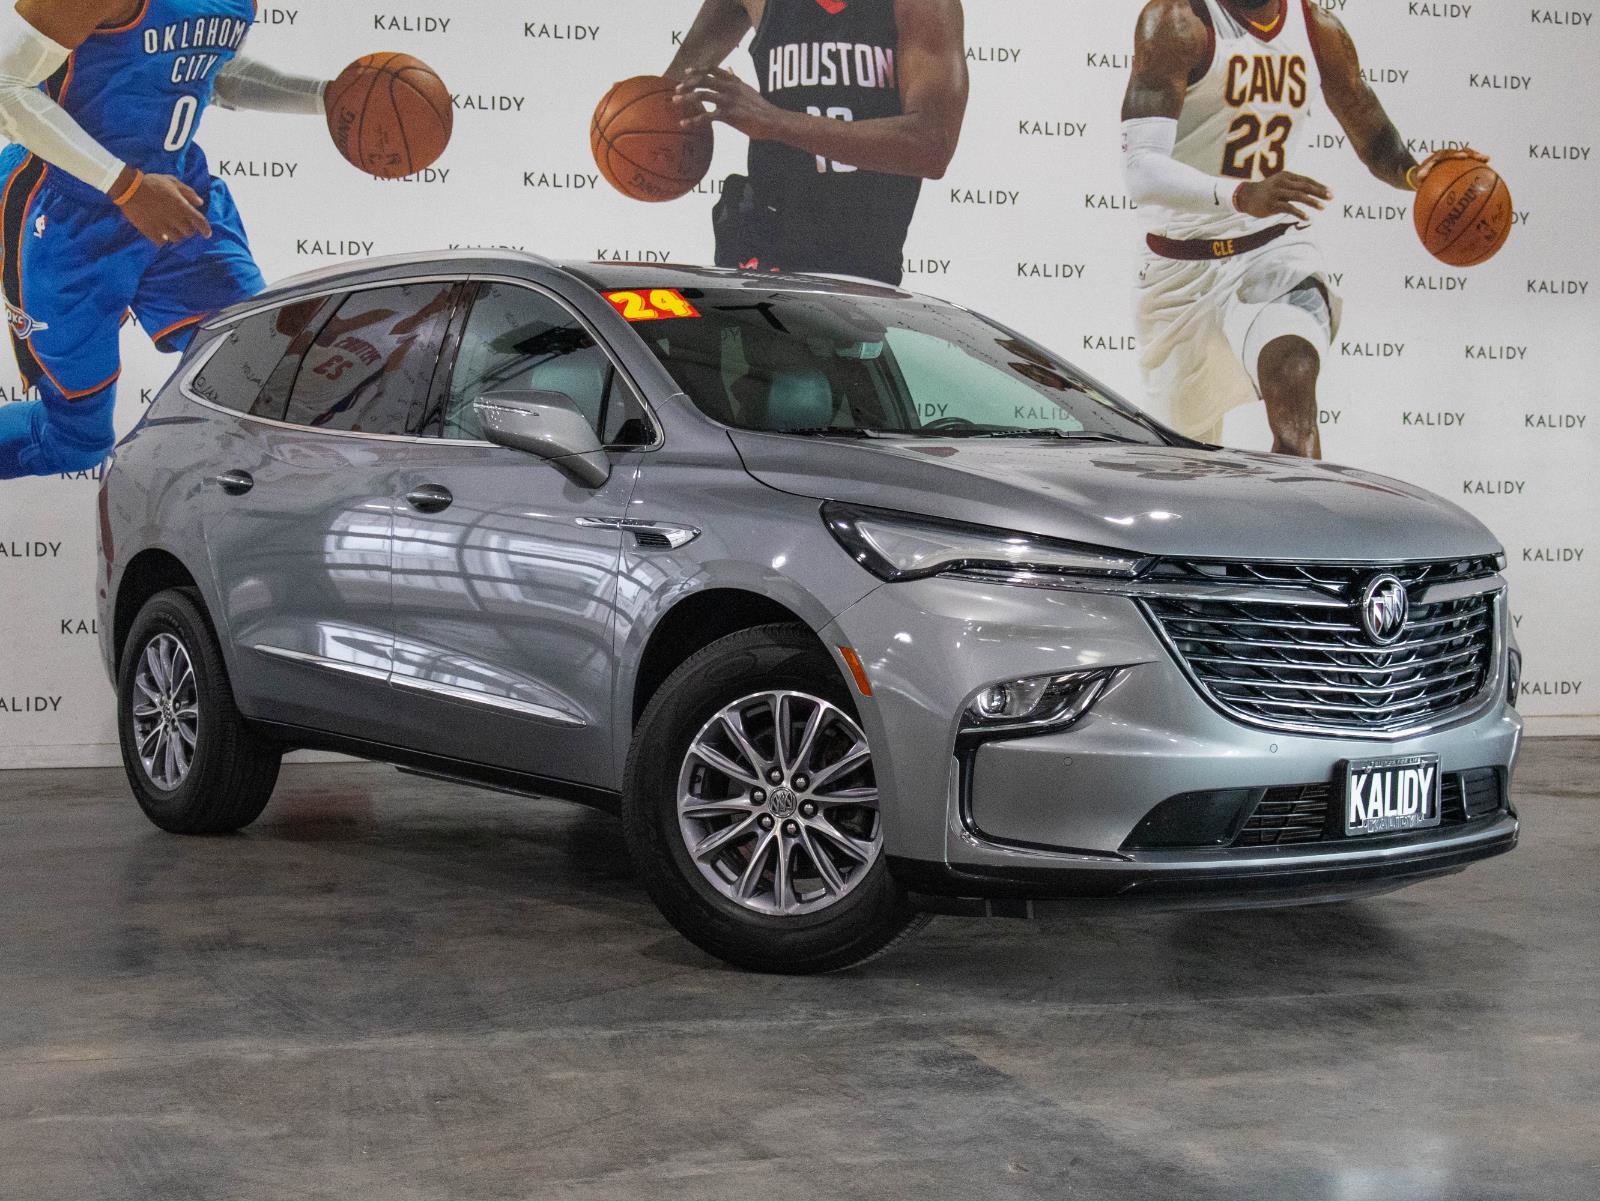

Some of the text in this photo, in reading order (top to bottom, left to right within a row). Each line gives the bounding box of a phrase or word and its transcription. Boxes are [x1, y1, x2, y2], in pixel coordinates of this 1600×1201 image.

[1409, 2, 1471, 18] KALIDY
[1532, 10, 1592, 26] KALIDY
[375, 15, 450, 33] KALIDY
[525, 23, 600, 41] KALIDY
[965, 47, 1020, 63] ALIDY
[1087, 53, 1134, 68] KALI
[171, 54, 218, 83] CITY
[768, 42, 895, 92] HOUSTON
[1224, 54, 1306, 108] CAVS
[1359, 68, 1408, 84] ALIDY
[1469, 74, 1531, 90] KALIDY
[450, 94, 524, 111] KALIDY
[164, 96, 198, 152] 0
[1020, 120, 1087, 137] KALIDY
[1220, 112, 1292, 180] 23
[1529, 144, 1591, 161] KALIDY
[219, 160, 298, 179] KALIDY
[524, 171, 598, 190] KALIDY
[950, 188, 1019, 206] KALIDY
[1343, 204, 1406, 221] KALIDY
[297, 239, 374, 257] KALIDY
[1212, 240, 1234, 256] CLE
[901, 259, 951, 274] LIDY
[1017, 262, 1085, 279] KALIDY
[1404, 275, 1467, 291] KALIDY
[1527, 279, 1588, 295] KALIDY
[608, 289, 692, 318] 24
[1083, 335, 1136, 351] KALID
[1341, 342, 1405, 357] KALIDY
[1465, 345, 1527, 360] KALIDY
[917, 403, 948, 418] IDY
[1014, 405, 1069, 421] KALID
[1402, 411, 1465, 426] KALIDY
[1525, 413, 1586, 429] KALIDY
[1463, 479, 1525, 495] KALIDY
[0, 541, 62, 558] ALIDY
[1523, 547, 1584, 562] KALIDY
[61, 618, 98, 635] KAL
[1520, 680, 1582, 695] KALIDY
[0, 695, 62, 712] ALIDY
[1350, 767, 1434, 823] KALIDY
